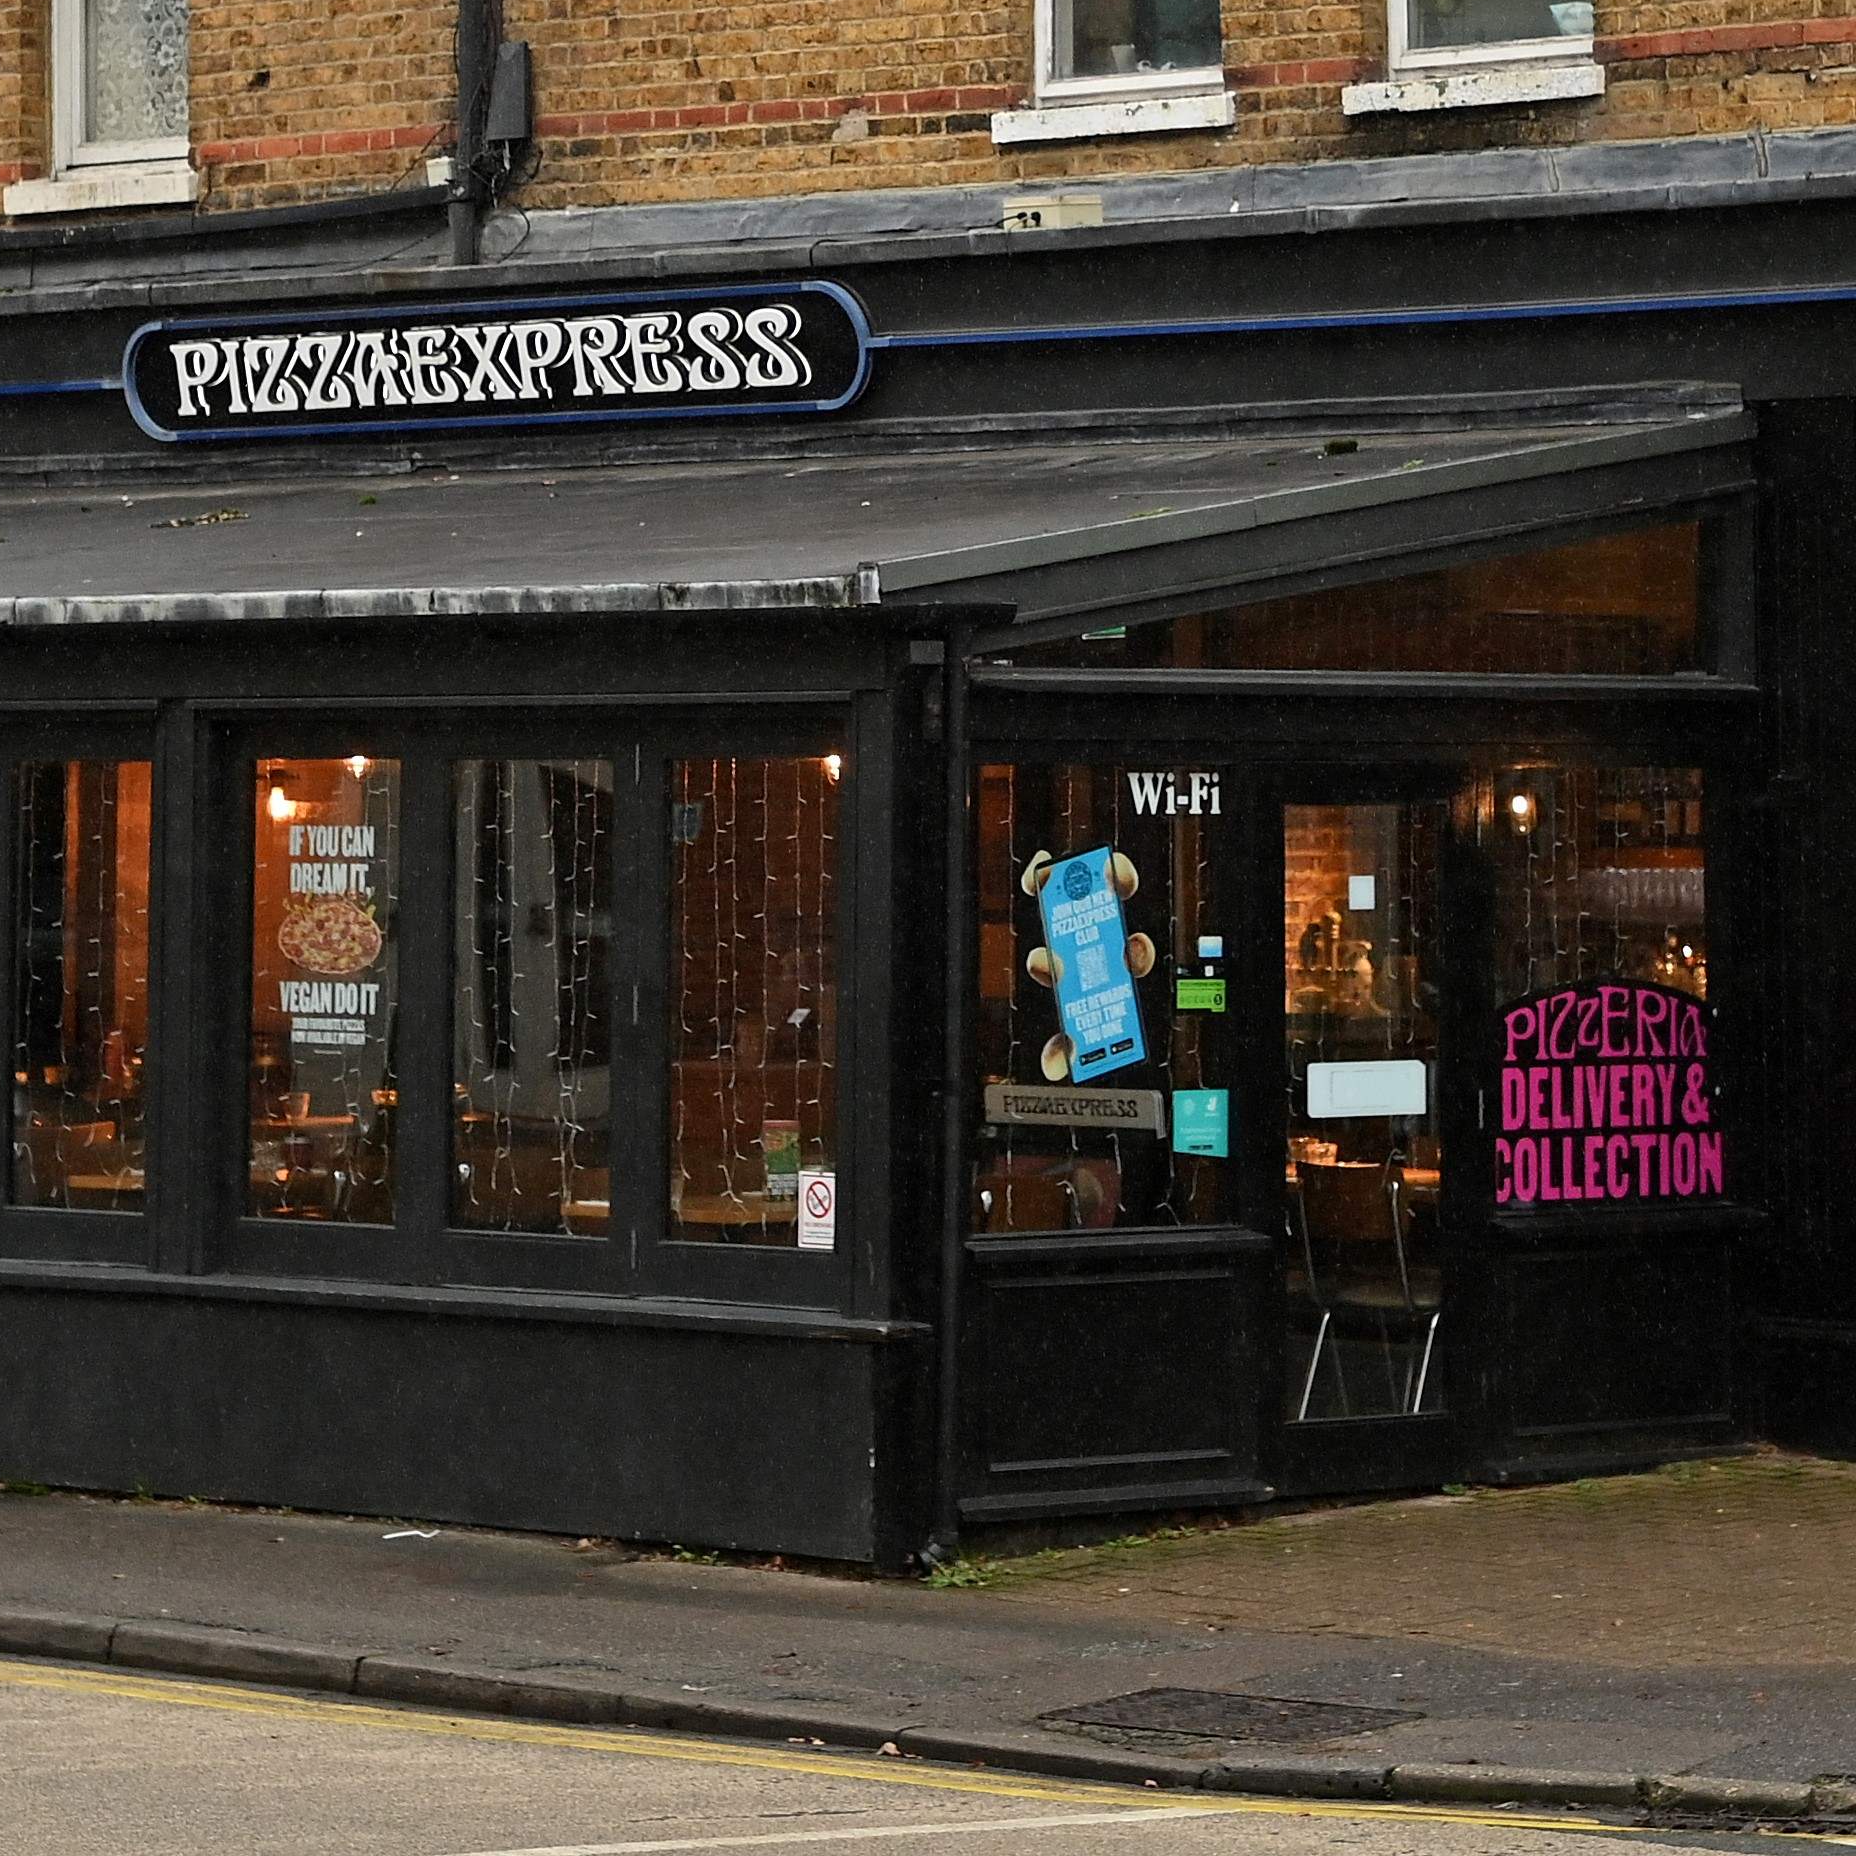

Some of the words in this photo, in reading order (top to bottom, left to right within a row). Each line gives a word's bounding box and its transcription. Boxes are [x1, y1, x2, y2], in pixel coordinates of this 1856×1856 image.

[170, 304, 812, 417] PIZZAEXPRESS
[1127, 772, 1221, 815] Wi-Fi
[289, 825, 304, 856] IF
[307, 825, 339, 857] YOU
[341, 825, 375, 857] CAN
[290, 863, 347, 894] DREAM
[279, 981, 332, 1013] VEGAN
[334, 983, 358, 1014] DO
[360, 983, 379, 1015] IT
[1504, 986, 1707, 1061] PIZZERIA
[1502, 1063, 1676, 1131] DELIVERY
[1681, 1062, 1709, 1125] &
[1496, 1131, 1722, 1204] COLLECTION
